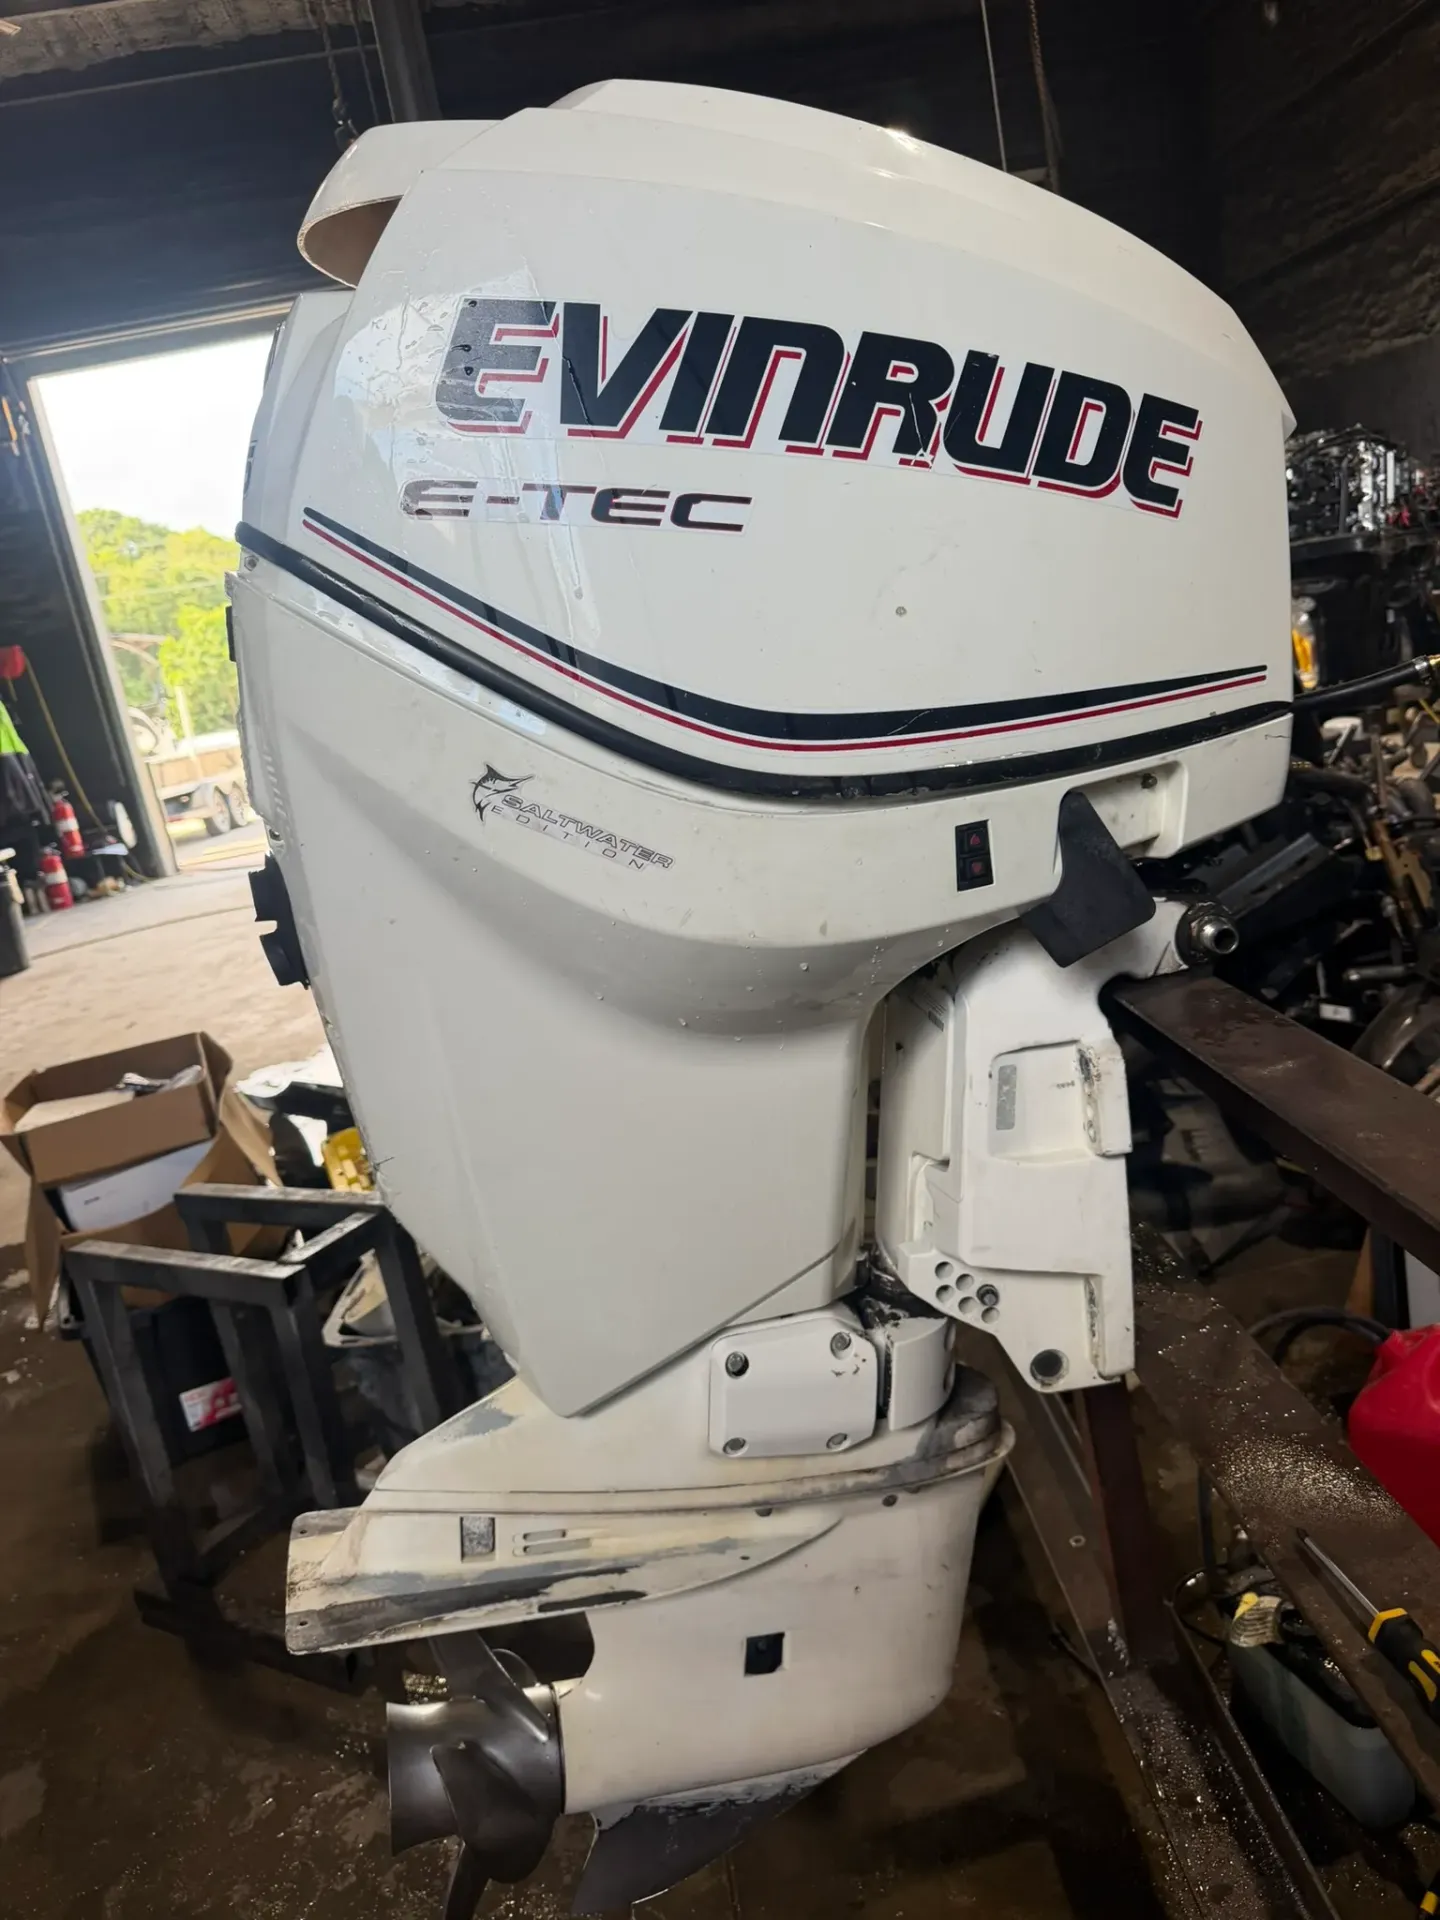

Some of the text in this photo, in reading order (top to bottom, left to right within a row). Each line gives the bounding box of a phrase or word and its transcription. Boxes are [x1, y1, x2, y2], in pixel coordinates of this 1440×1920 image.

[435, 299, 1202, 518] EVINRUDE
[401, 480, 753, 532] E-TEC
[491, 805, 644, 870] EDITION
[501, 794, 674, 869] SALTWATER
